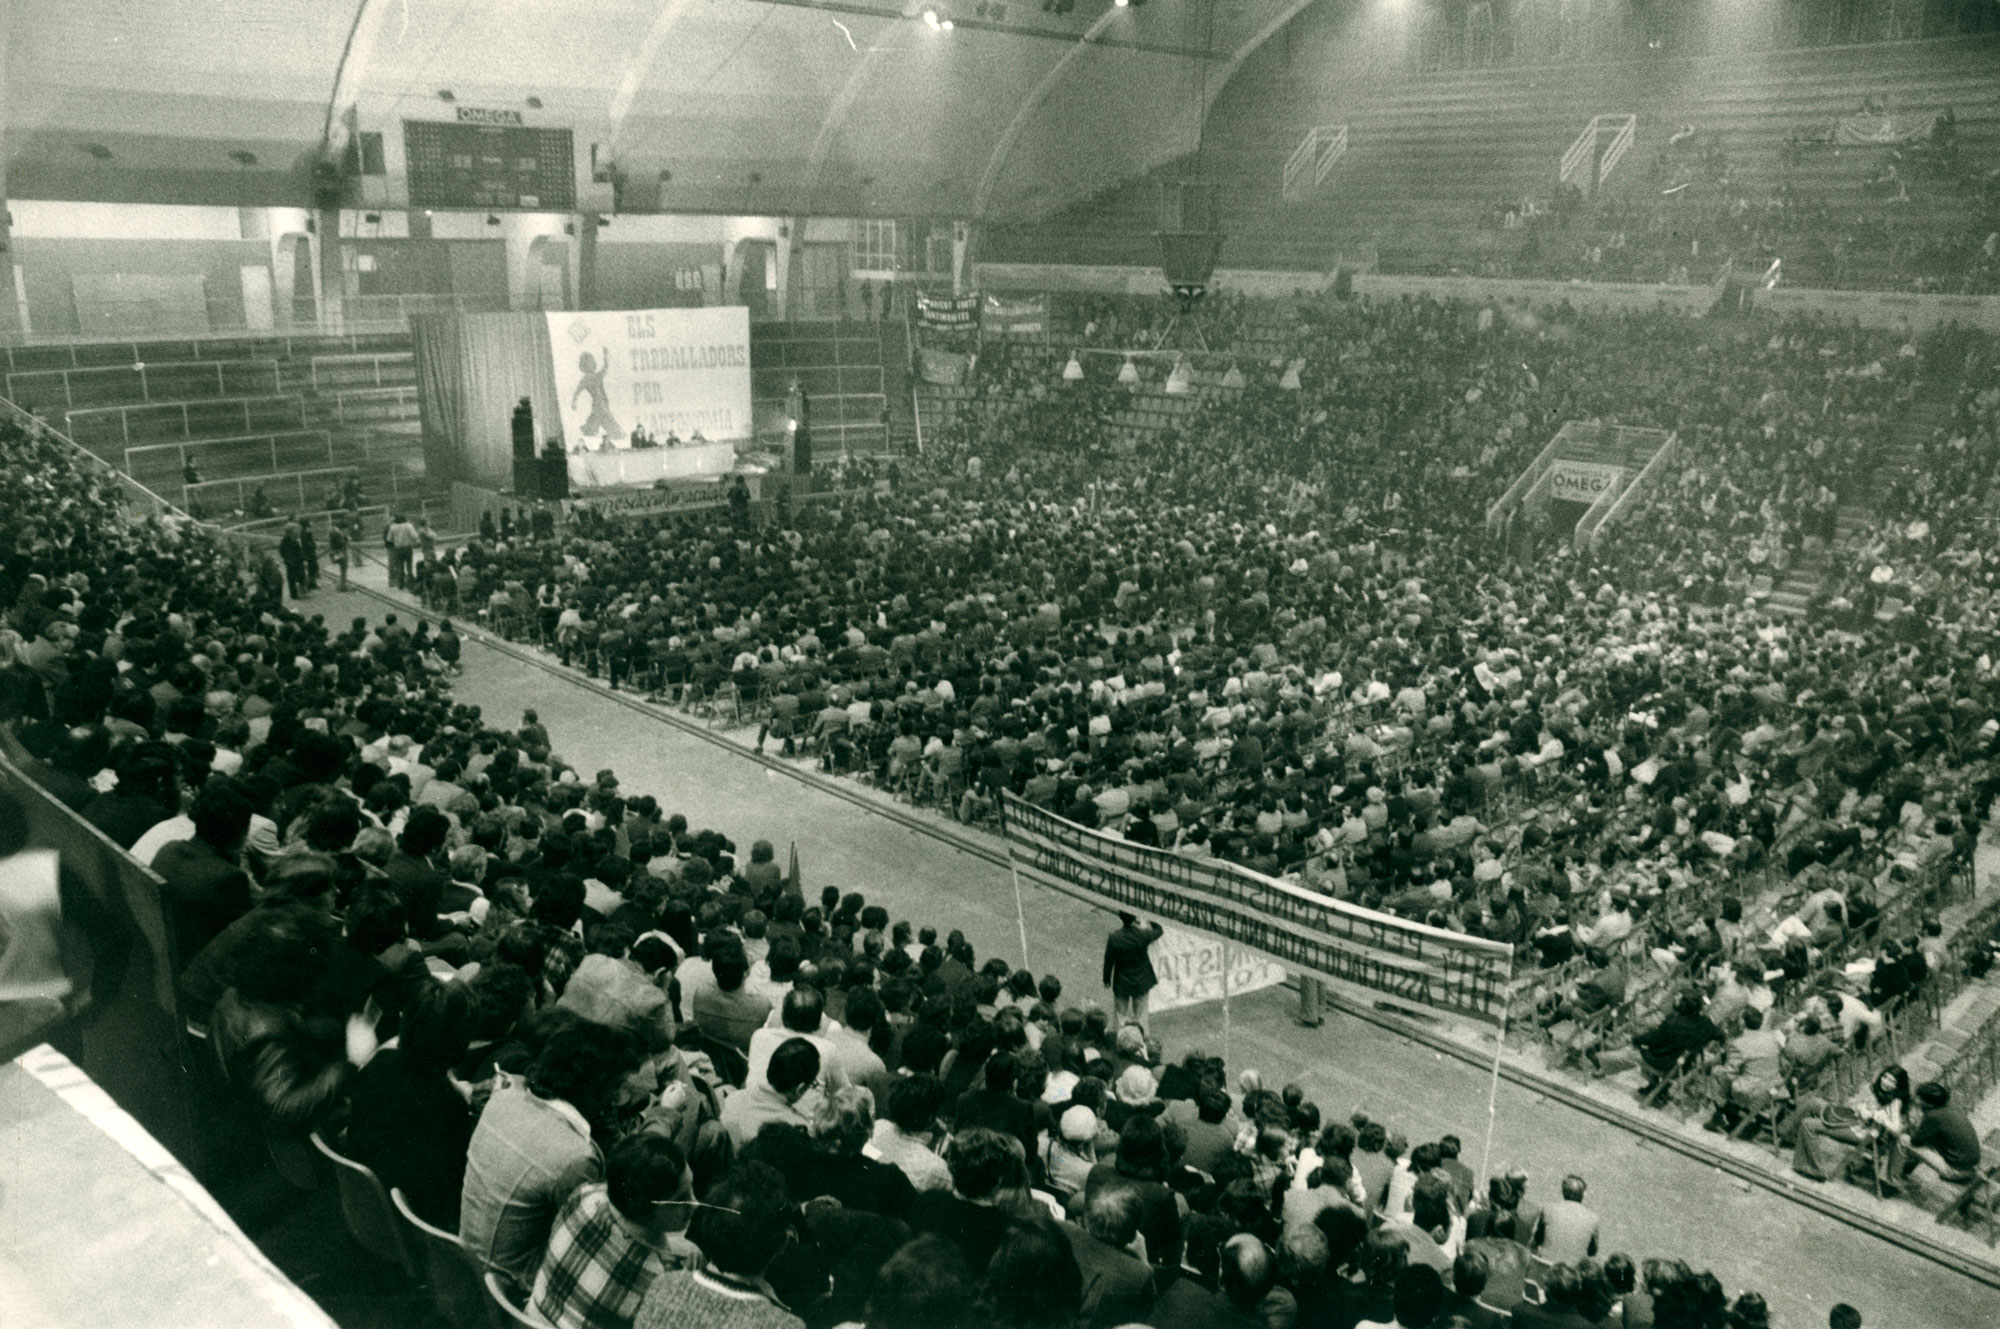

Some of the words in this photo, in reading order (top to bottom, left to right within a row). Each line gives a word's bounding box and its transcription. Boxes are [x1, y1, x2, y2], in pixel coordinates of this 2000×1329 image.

[460, 108, 516, 122] OMEGA
[627, 315, 656, 339] ELS
[631, 344, 746, 372] TREBALLADORS
[633, 382, 663, 405] PER
